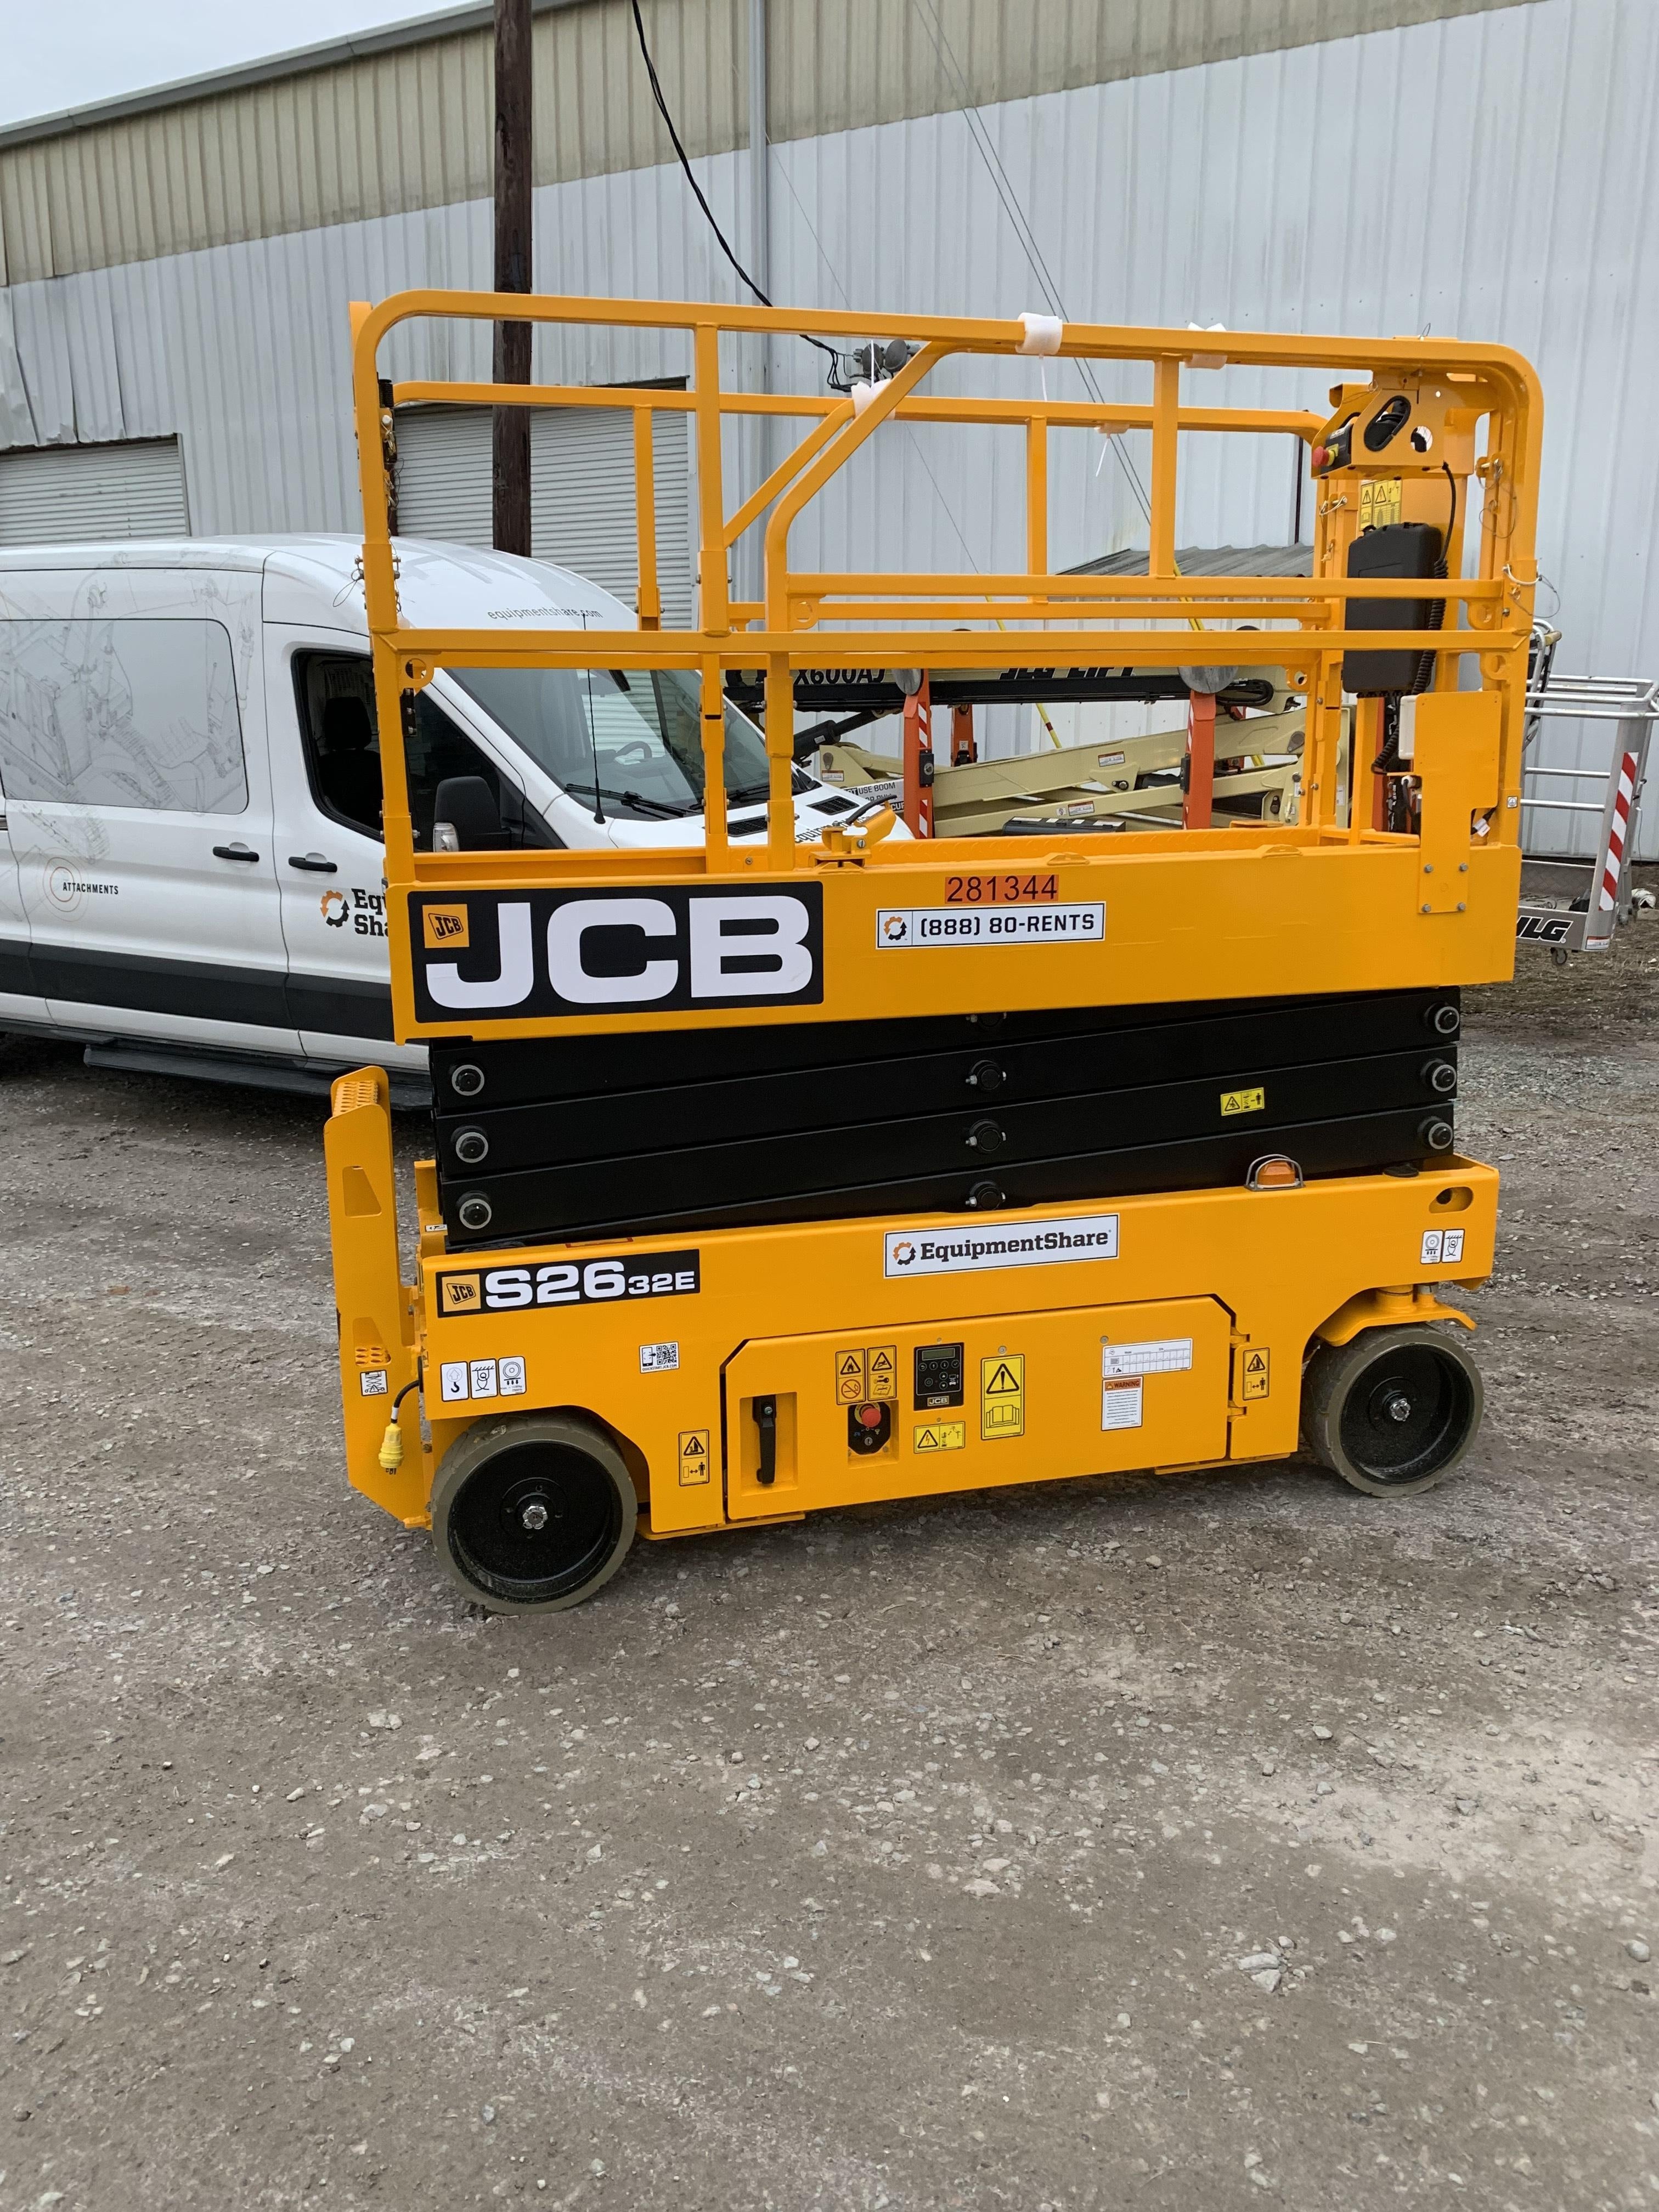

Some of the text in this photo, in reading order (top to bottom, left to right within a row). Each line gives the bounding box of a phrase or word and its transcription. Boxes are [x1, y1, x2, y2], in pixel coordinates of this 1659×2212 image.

[488, 607, 603, 620] equipmentshare.com
[859, 786, 872, 794] USE
[874, 782, 895, 792] BOOM
[63, 882, 119, 895] ATTACHMENTS
[947, 875, 1057, 902] 281344
[436, 916, 462, 939] JCB
[921, 914, 1094, 938] (888) 80-RENTS
[1516, 916, 1573, 942] JLG
[426, 895, 813, 1009] JCB
[921, 1232, 1109, 1262] EquipmentShare
[452, 1285, 475, 1302] JCB
